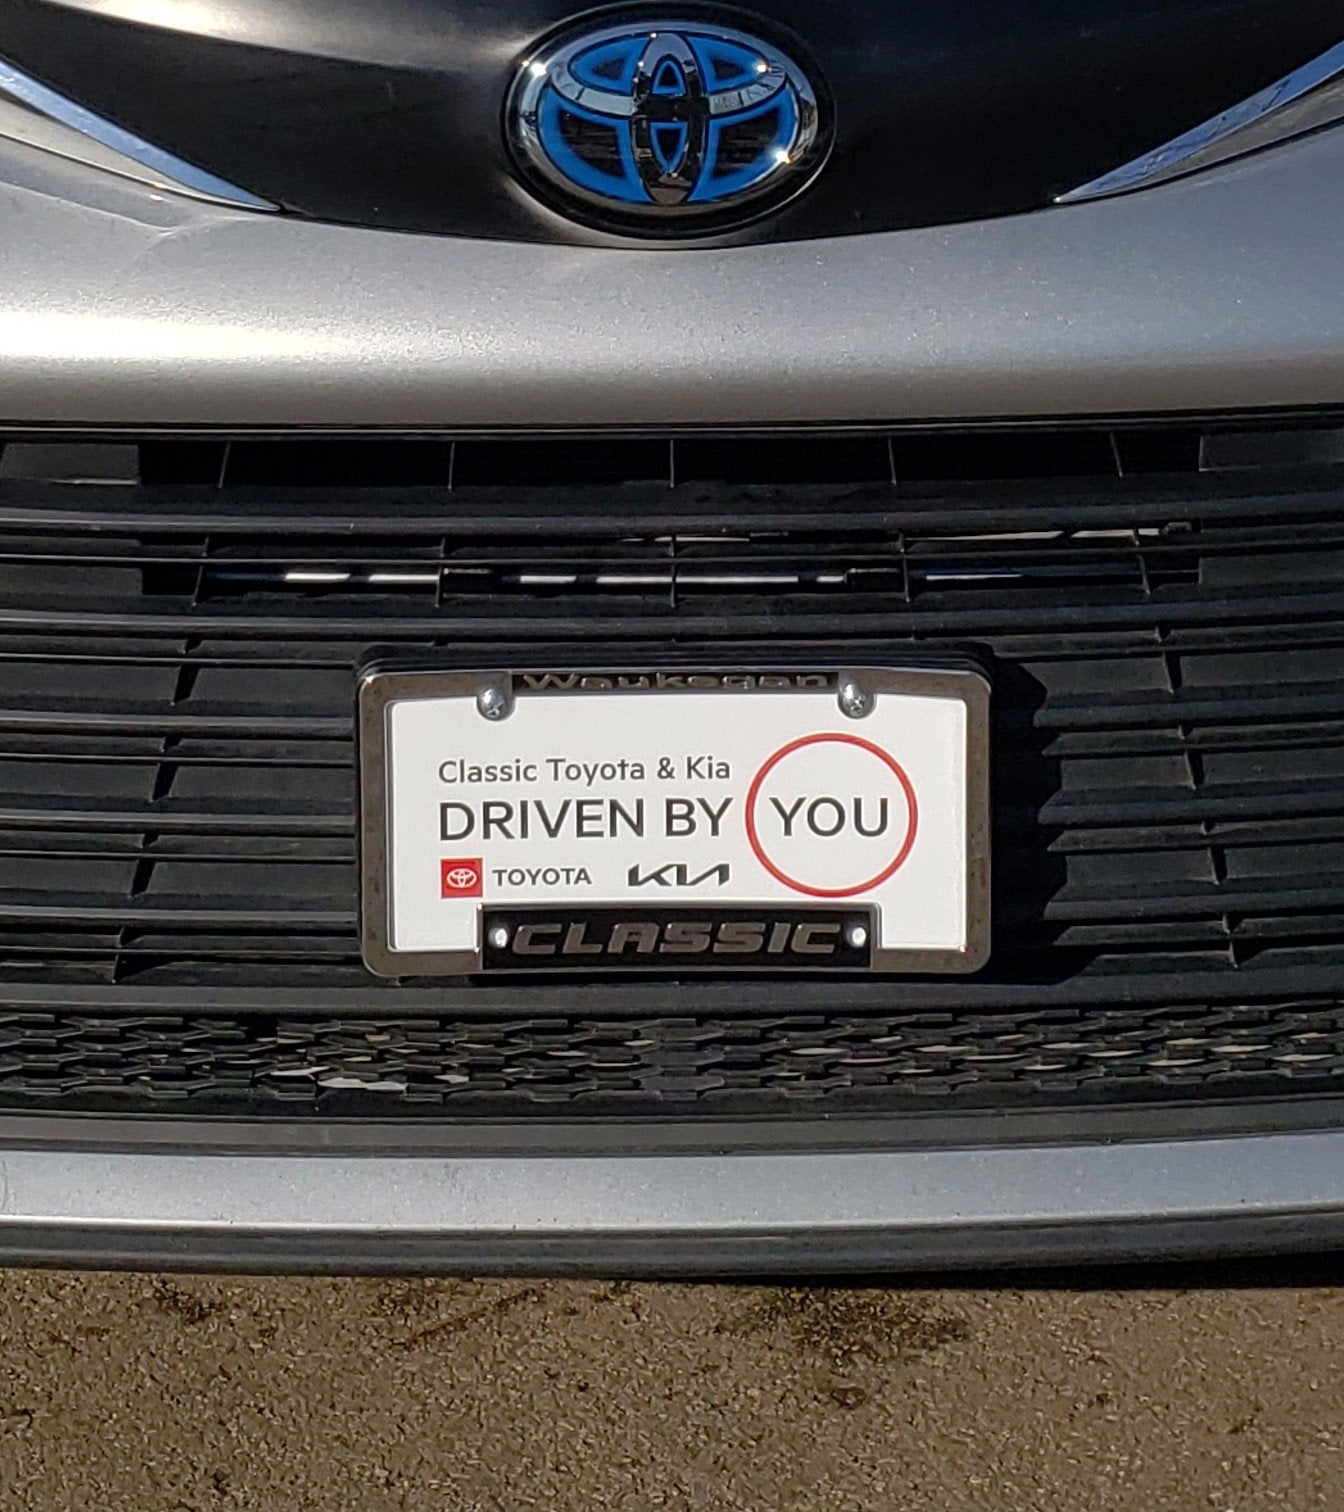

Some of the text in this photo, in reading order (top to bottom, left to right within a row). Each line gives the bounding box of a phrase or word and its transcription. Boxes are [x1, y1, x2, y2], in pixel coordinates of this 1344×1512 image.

[438, 756, 731, 787] Classic Toyota & Kia
[440, 796, 889, 841] DRIVEN BY YOU
[492, 867, 593, 886] TOYOTA
[512, 923, 842, 955] CLASSIC
